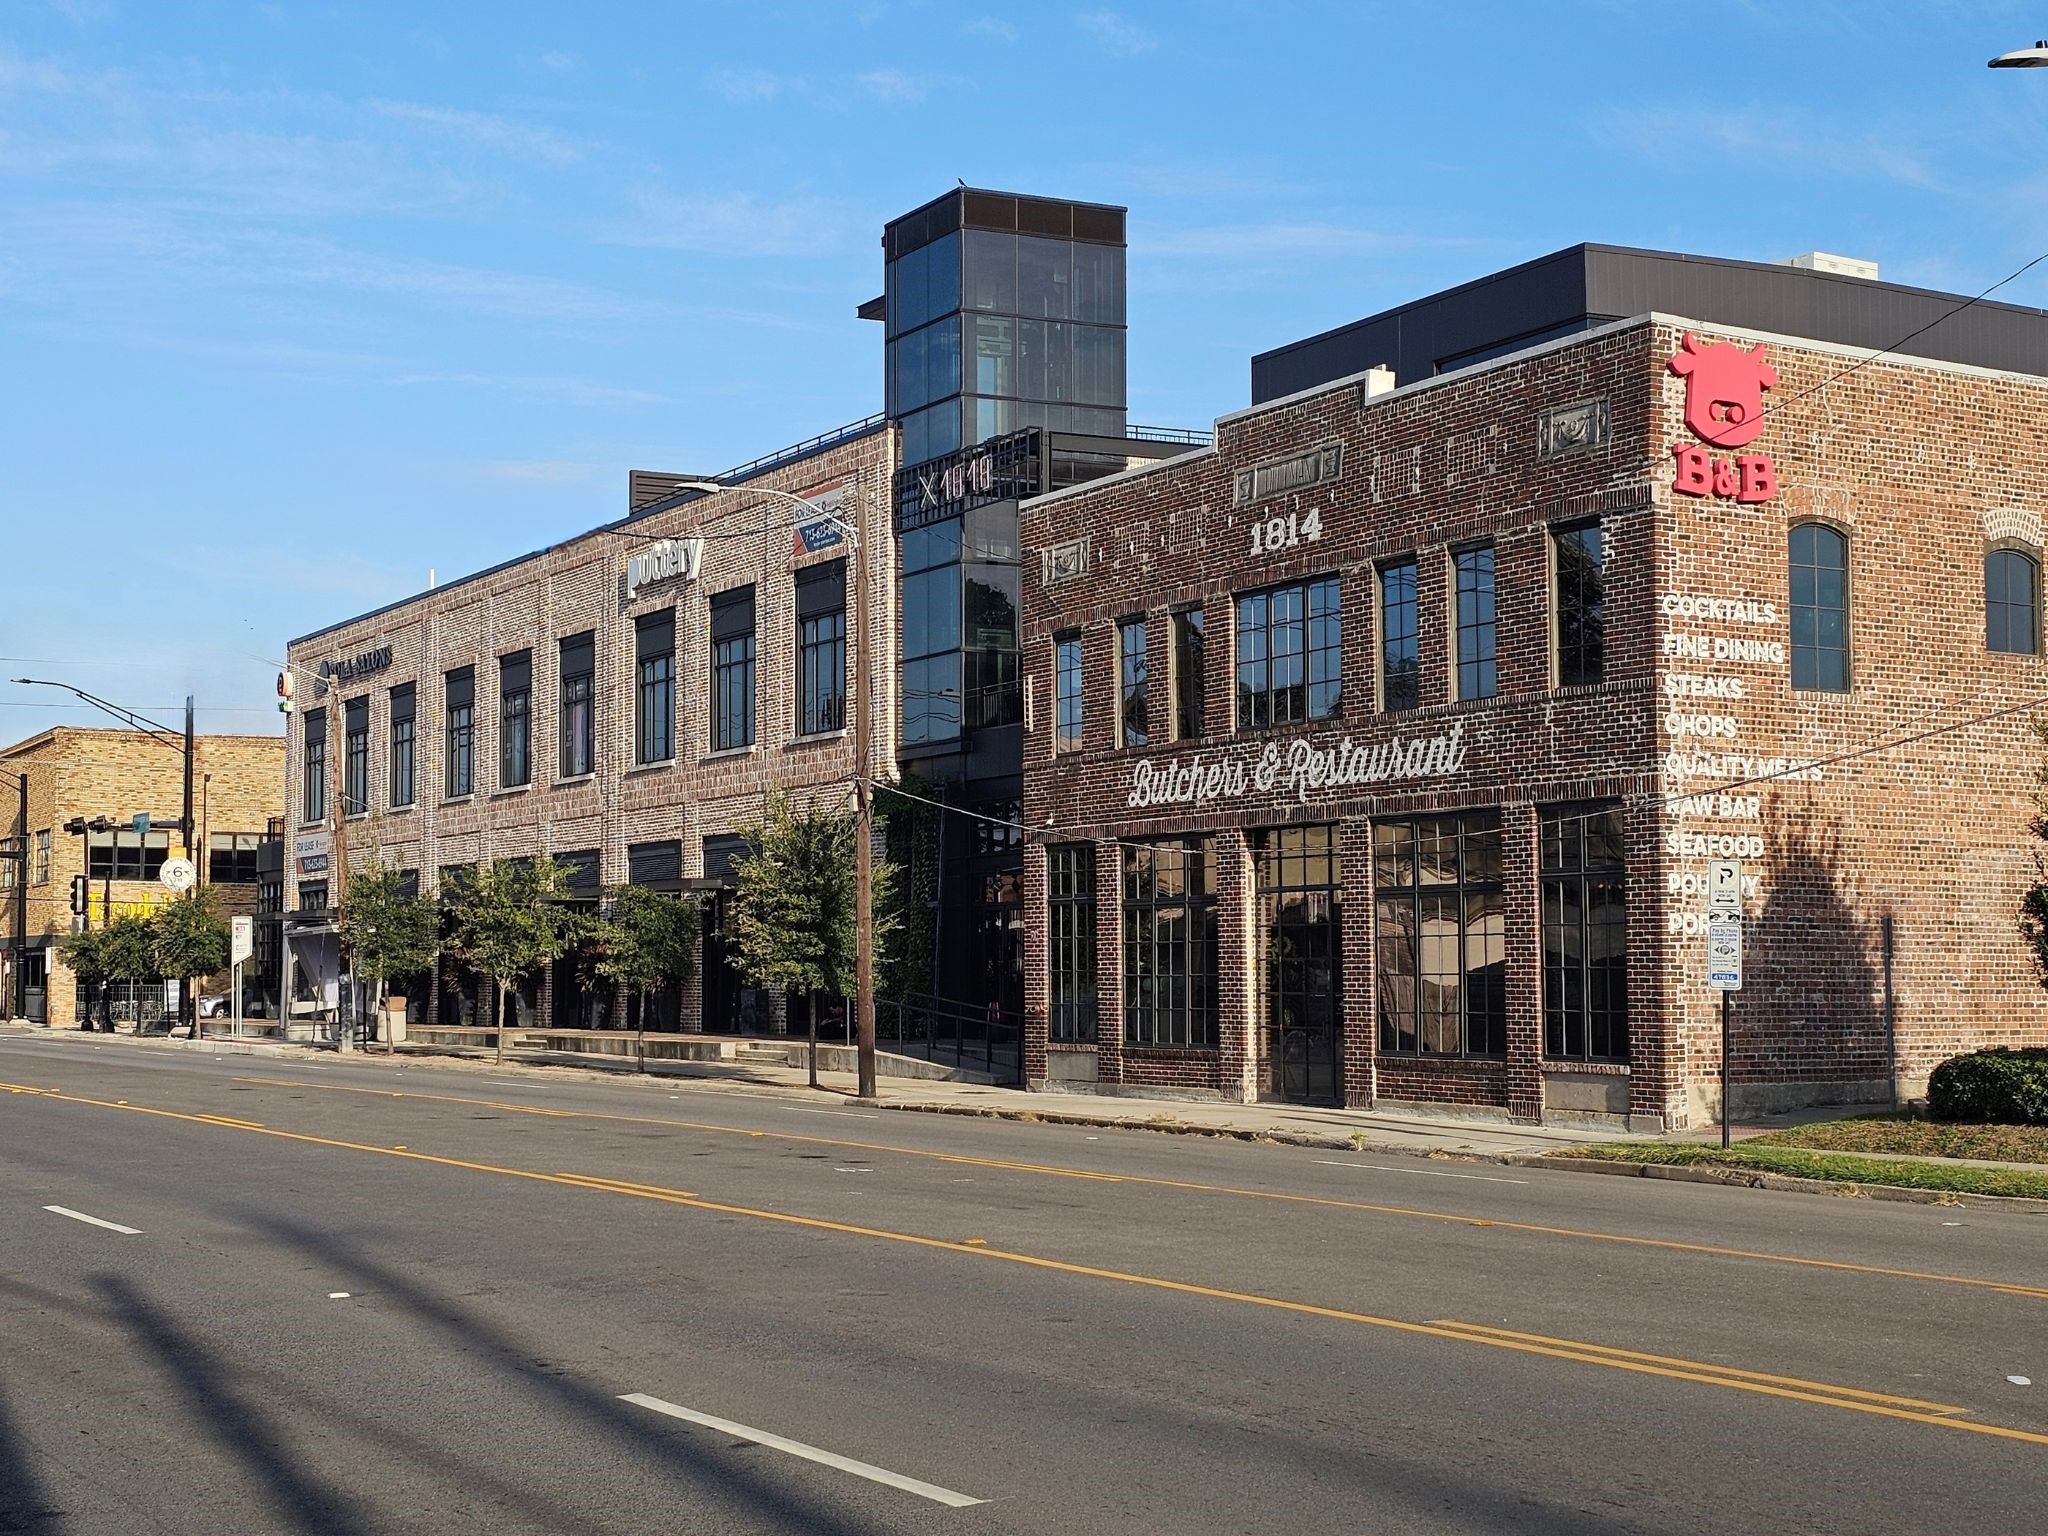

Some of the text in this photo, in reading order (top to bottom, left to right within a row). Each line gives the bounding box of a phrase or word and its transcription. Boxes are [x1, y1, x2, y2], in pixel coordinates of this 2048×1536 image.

[1672, 443, 1778, 504] B&B
[1251, 508, 1323, 556] 1814
[1662, 594, 1776, 623] COCKTAILS
[356, 645, 393, 672] SALONS
[1663, 634, 1783, 663] FINE DINING
[1664, 673, 1743, 698] STEAKS
[1664, 713, 1737, 738] CHOPS
[1128, 721, 1466, 808] Butchers & Restaurant
[1665, 753, 1823, 781] QUALITY MEATS
[1666, 793, 1761, 818] RAW BAR
[1667, 833, 1764, 857] SEAFOOD
[173, 866, 183, 877] 6
[1669, 913, 1710, 935] POR
